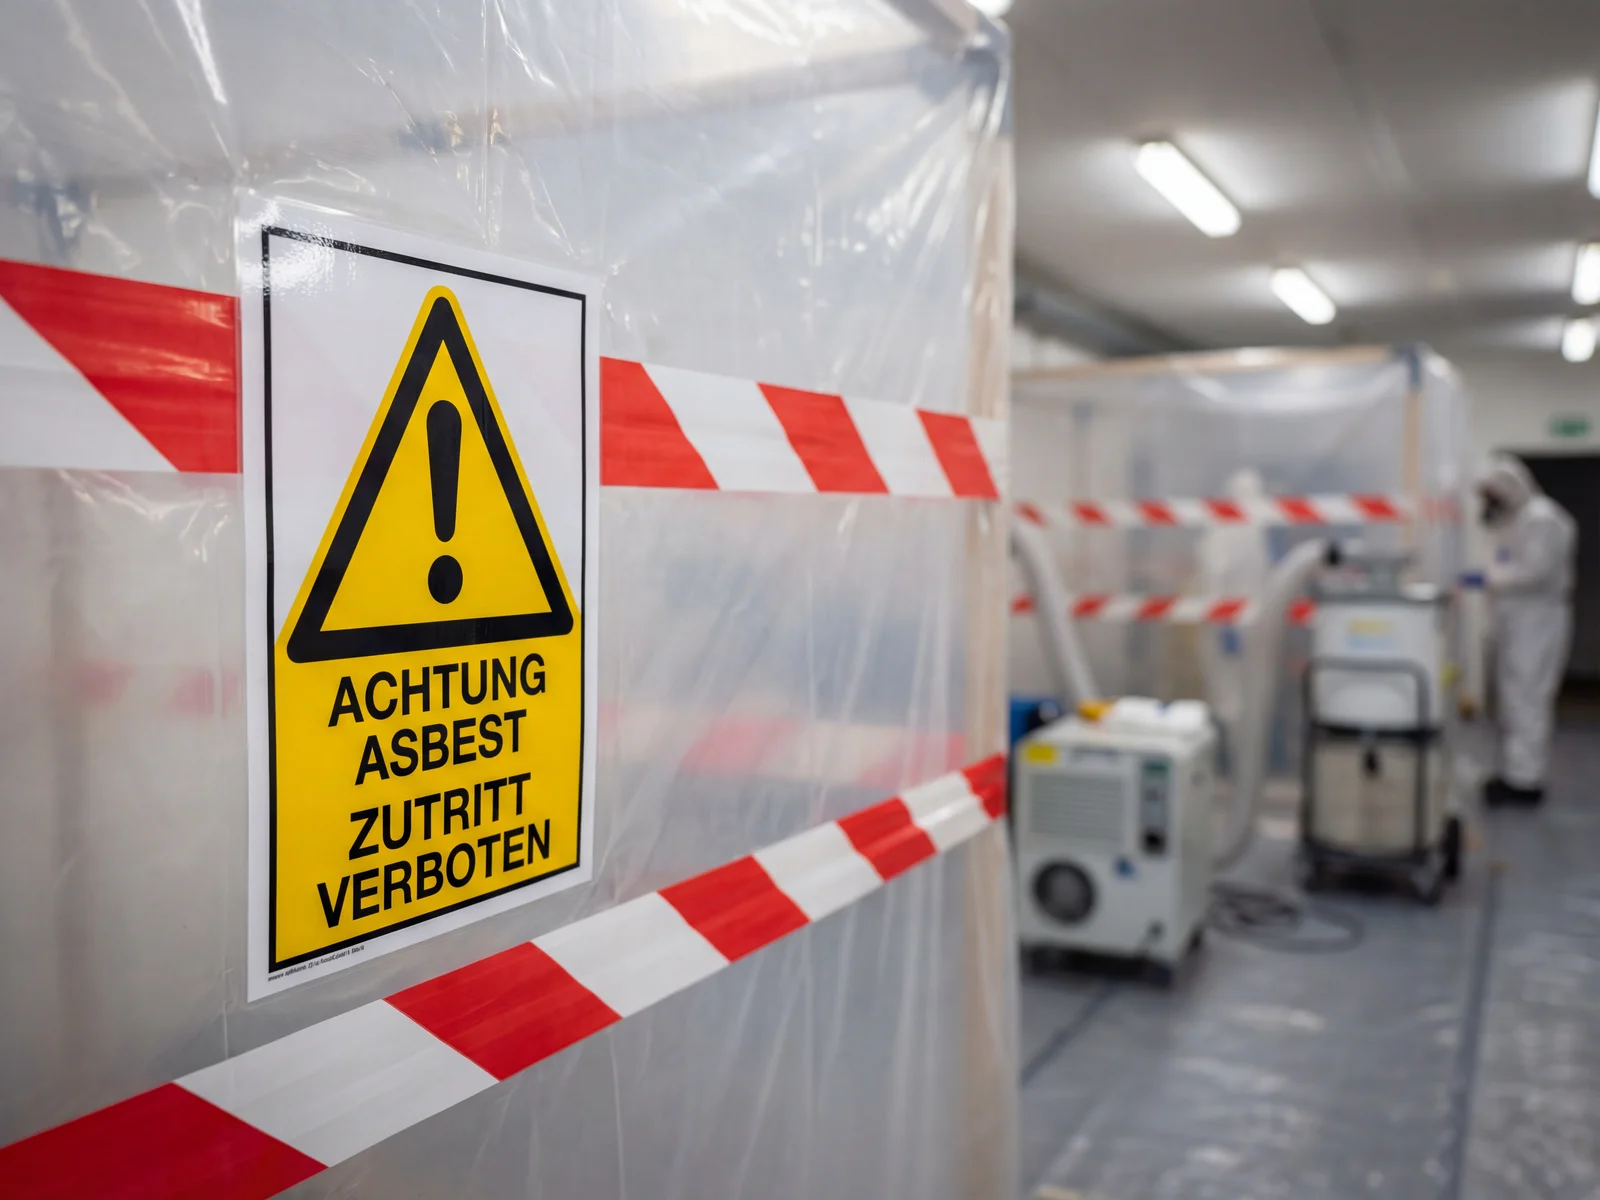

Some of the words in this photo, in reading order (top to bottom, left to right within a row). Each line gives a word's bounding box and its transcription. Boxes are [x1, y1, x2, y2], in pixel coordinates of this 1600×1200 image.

[328, 653, 546, 727] ACHTUNG
[355, 709, 527, 786] ASBEST
[349, 772, 531, 860] ZUTRITT
[317, 819, 551, 928] VERBOTEN
